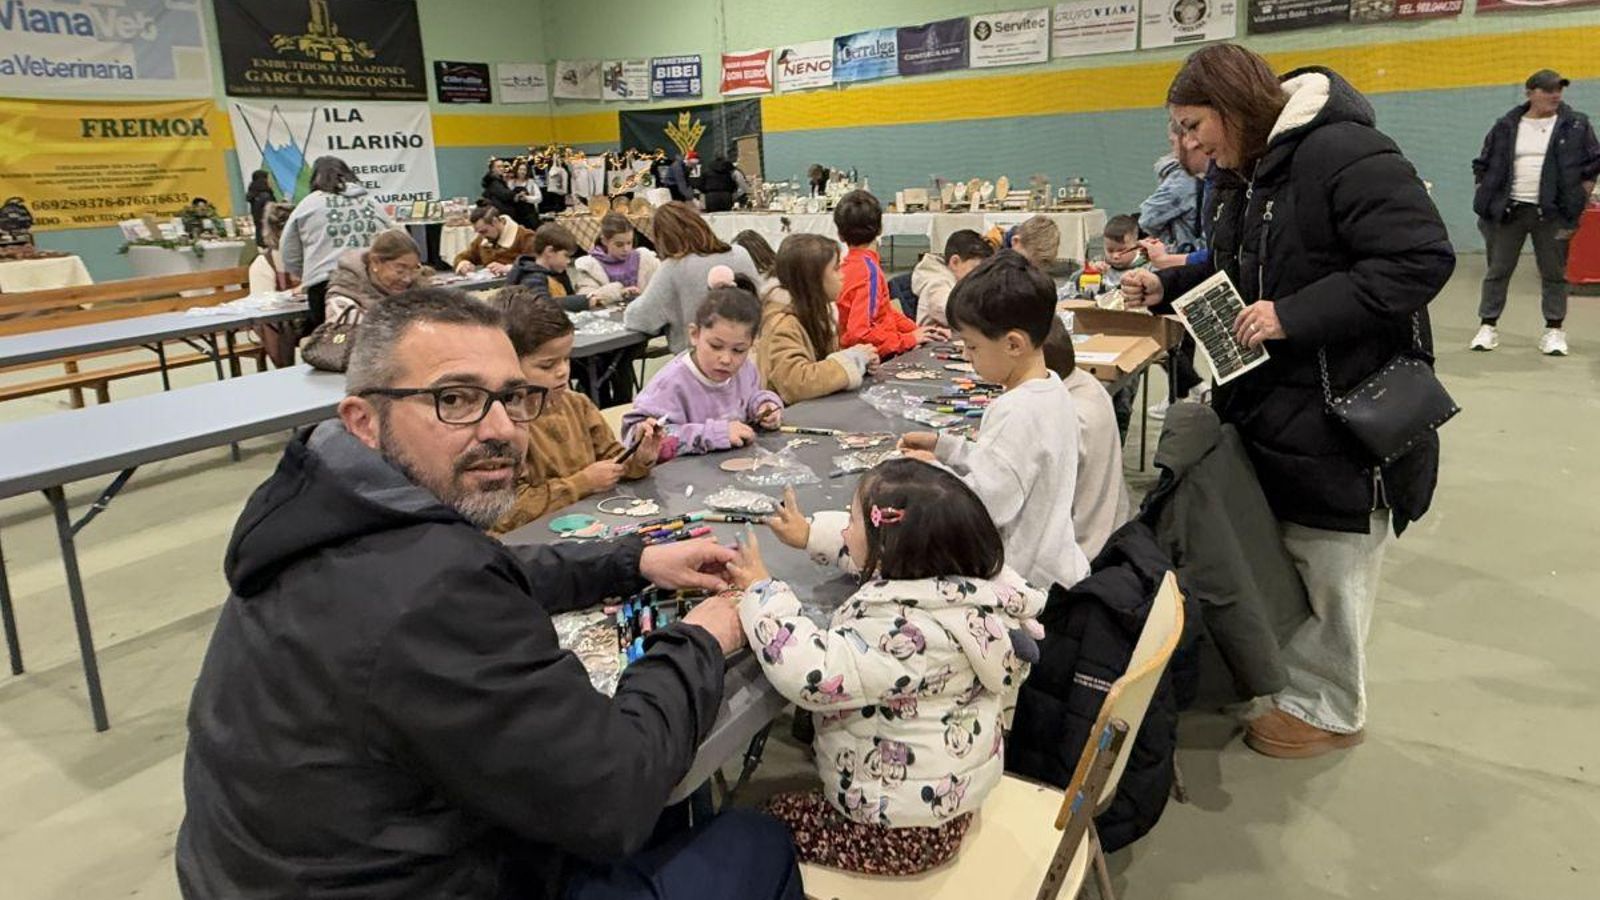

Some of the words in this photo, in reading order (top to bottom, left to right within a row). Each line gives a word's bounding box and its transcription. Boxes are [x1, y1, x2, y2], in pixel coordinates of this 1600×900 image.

[1054, 8, 1093, 23] GRUPO
[1093, 4, 1137, 17] VIANA
[994, 16, 1046, 34] Servitec
[842, 39, 895, 61] Cerralga
[0, 54, 134, 80] aVeterinaria
[252, 58, 328, 72] EMBUTIDOS
[330, 63, 337, 72] Y
[340, 64, 407, 75] SALAZONES
[656, 64, 699, 78] BIBEI
[783, 60, 833, 77] NENO
[245, 69, 316, 85] GARCÍA
[318, 74, 388, 88] MARCOS
[351, 163, 407, 175] BERGUE
[326, 220, 377, 237] GOOD
